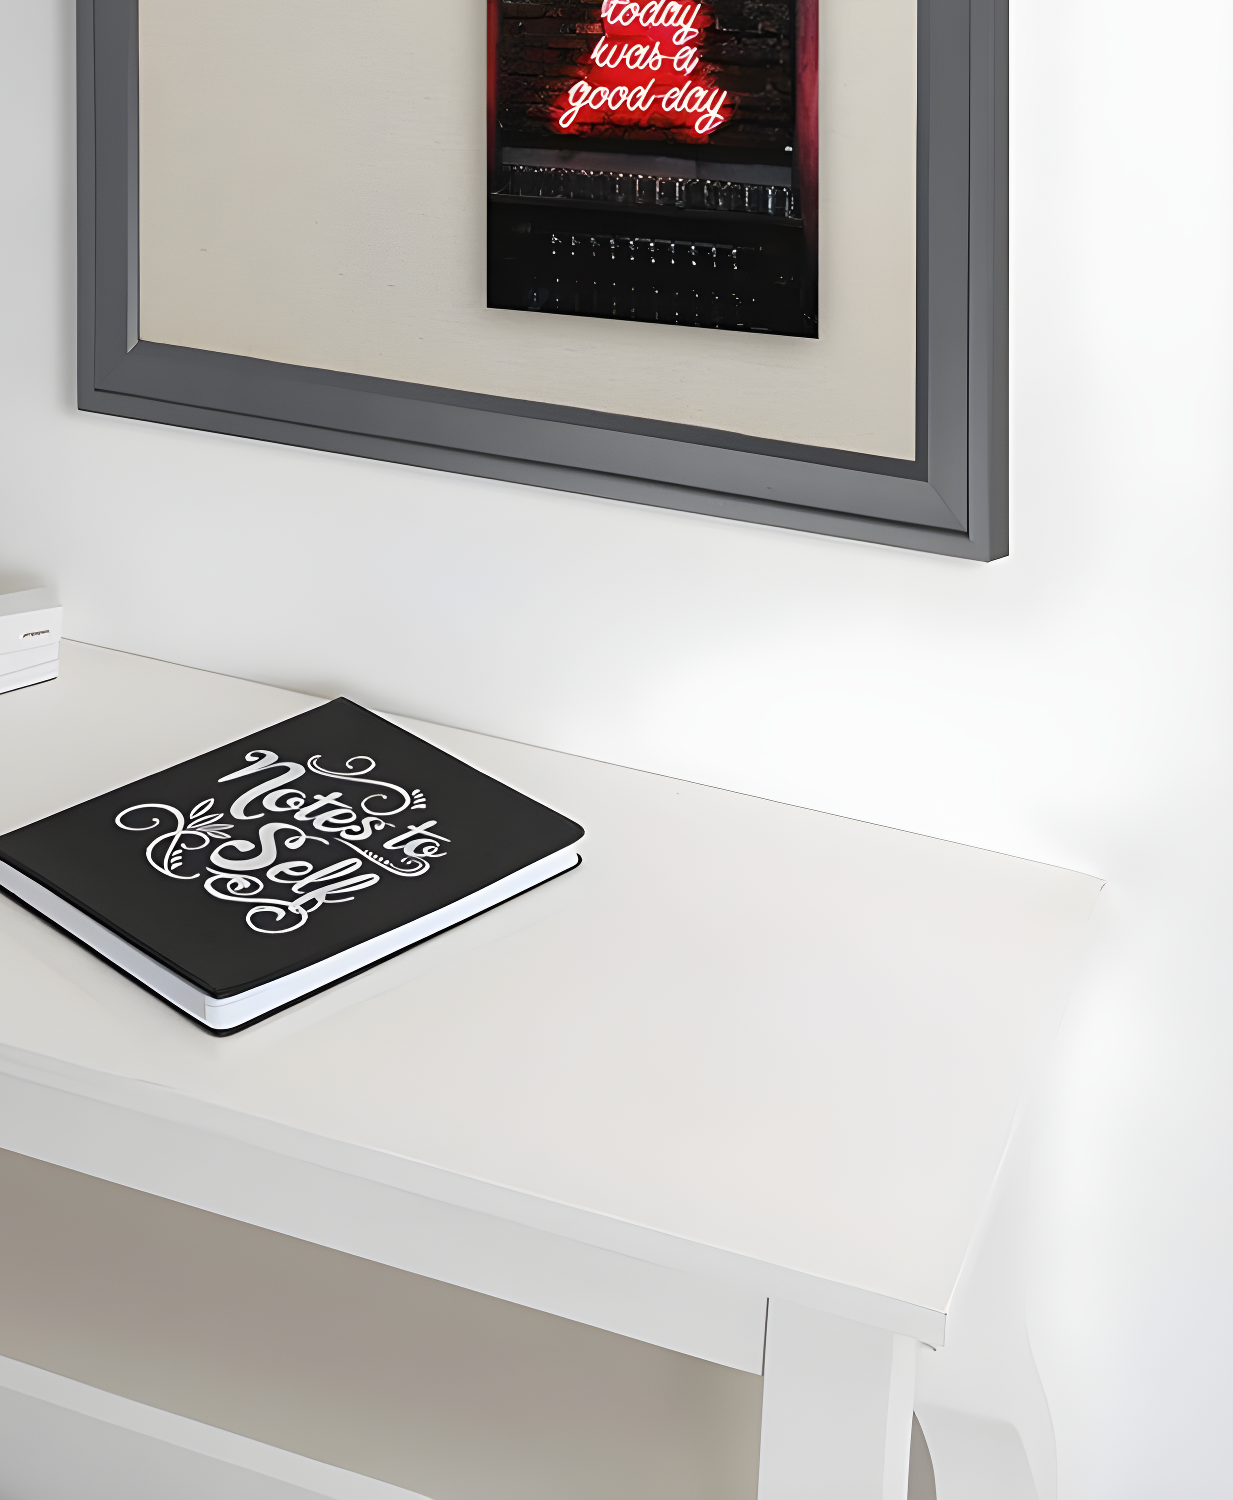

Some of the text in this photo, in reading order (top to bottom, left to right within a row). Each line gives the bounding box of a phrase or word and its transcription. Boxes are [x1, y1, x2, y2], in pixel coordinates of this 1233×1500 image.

[591, 35, 699, 76] was a
[559, 78, 728, 135] good day
[217, 749, 451, 860] Notes to
[209, 822, 380, 914] Self
